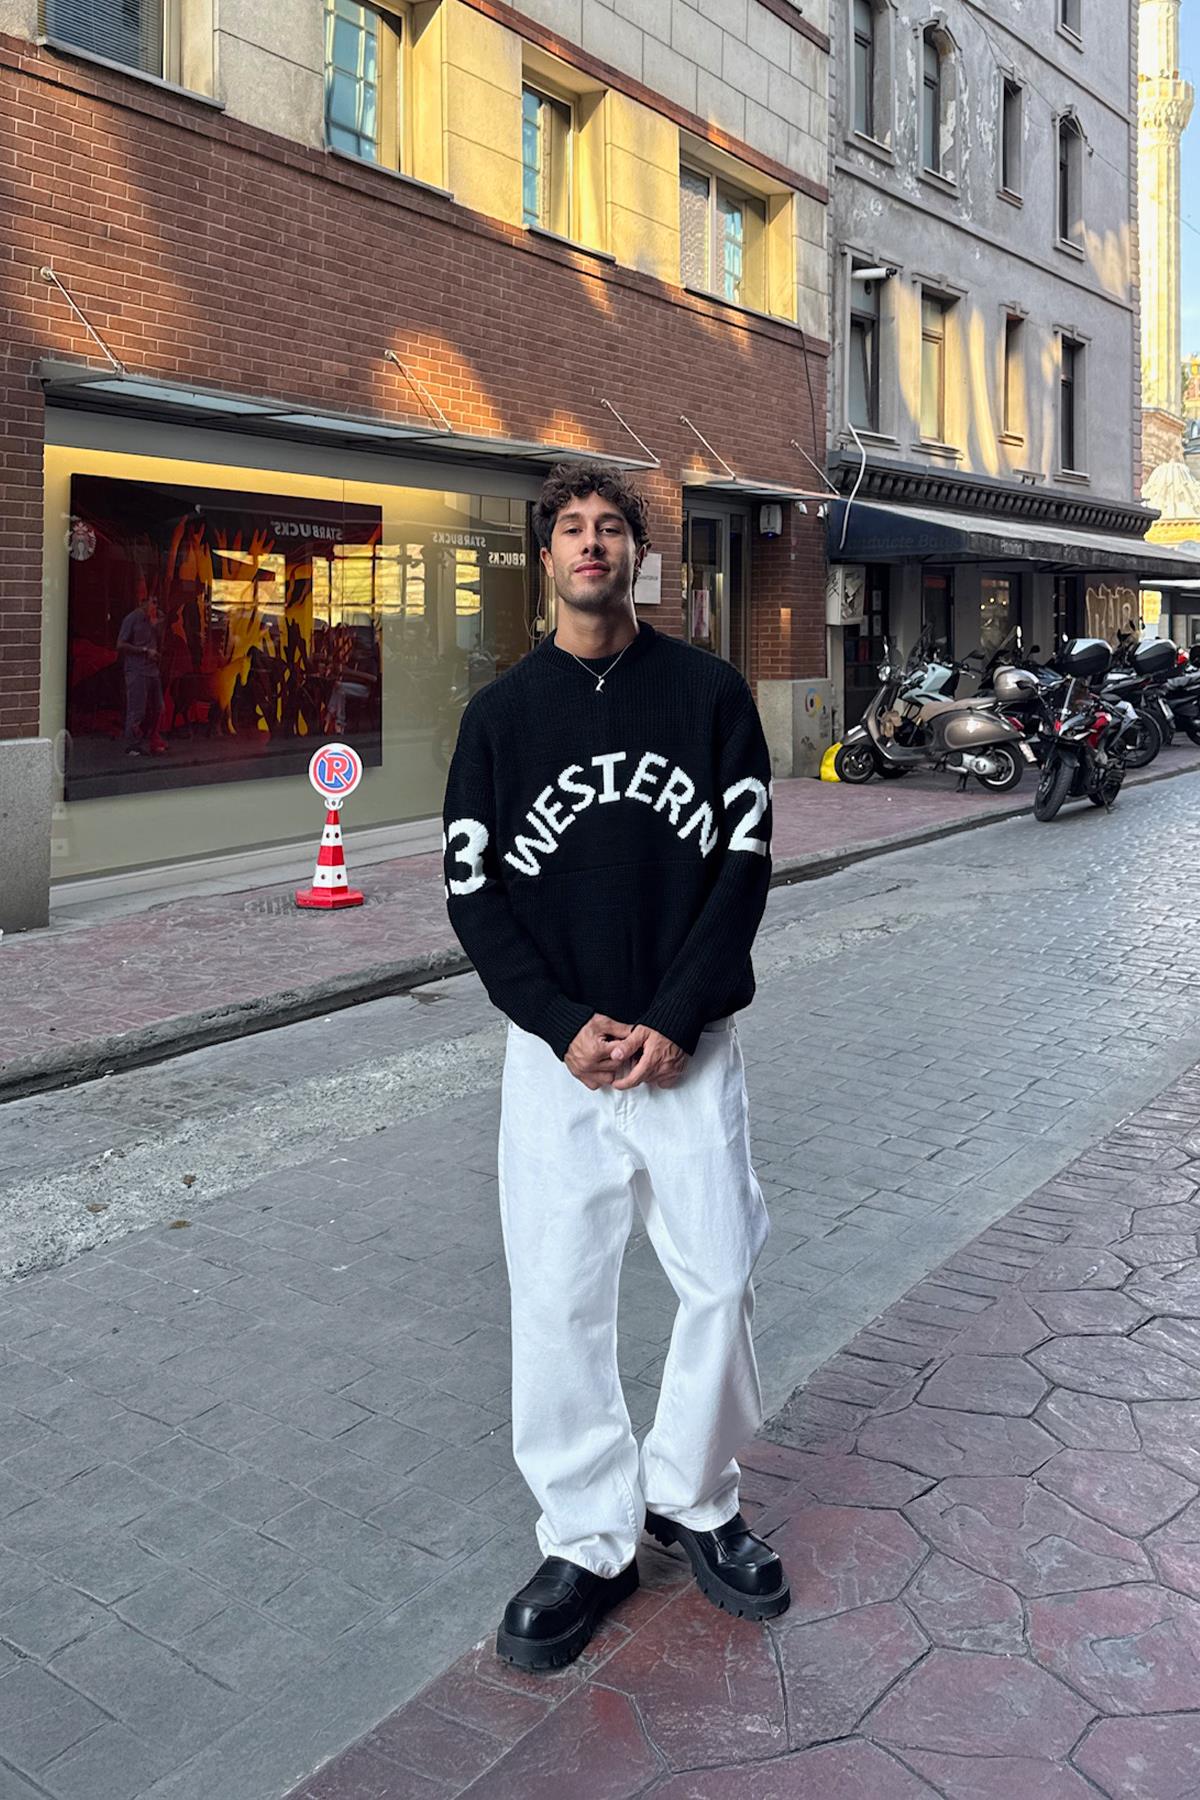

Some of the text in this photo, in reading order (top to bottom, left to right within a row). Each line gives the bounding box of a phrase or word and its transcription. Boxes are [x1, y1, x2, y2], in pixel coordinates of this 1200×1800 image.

[504, 752, 718, 876] WESTERN
[723, 776, 774, 857] 2
[443, 818, 489, 899] 3
